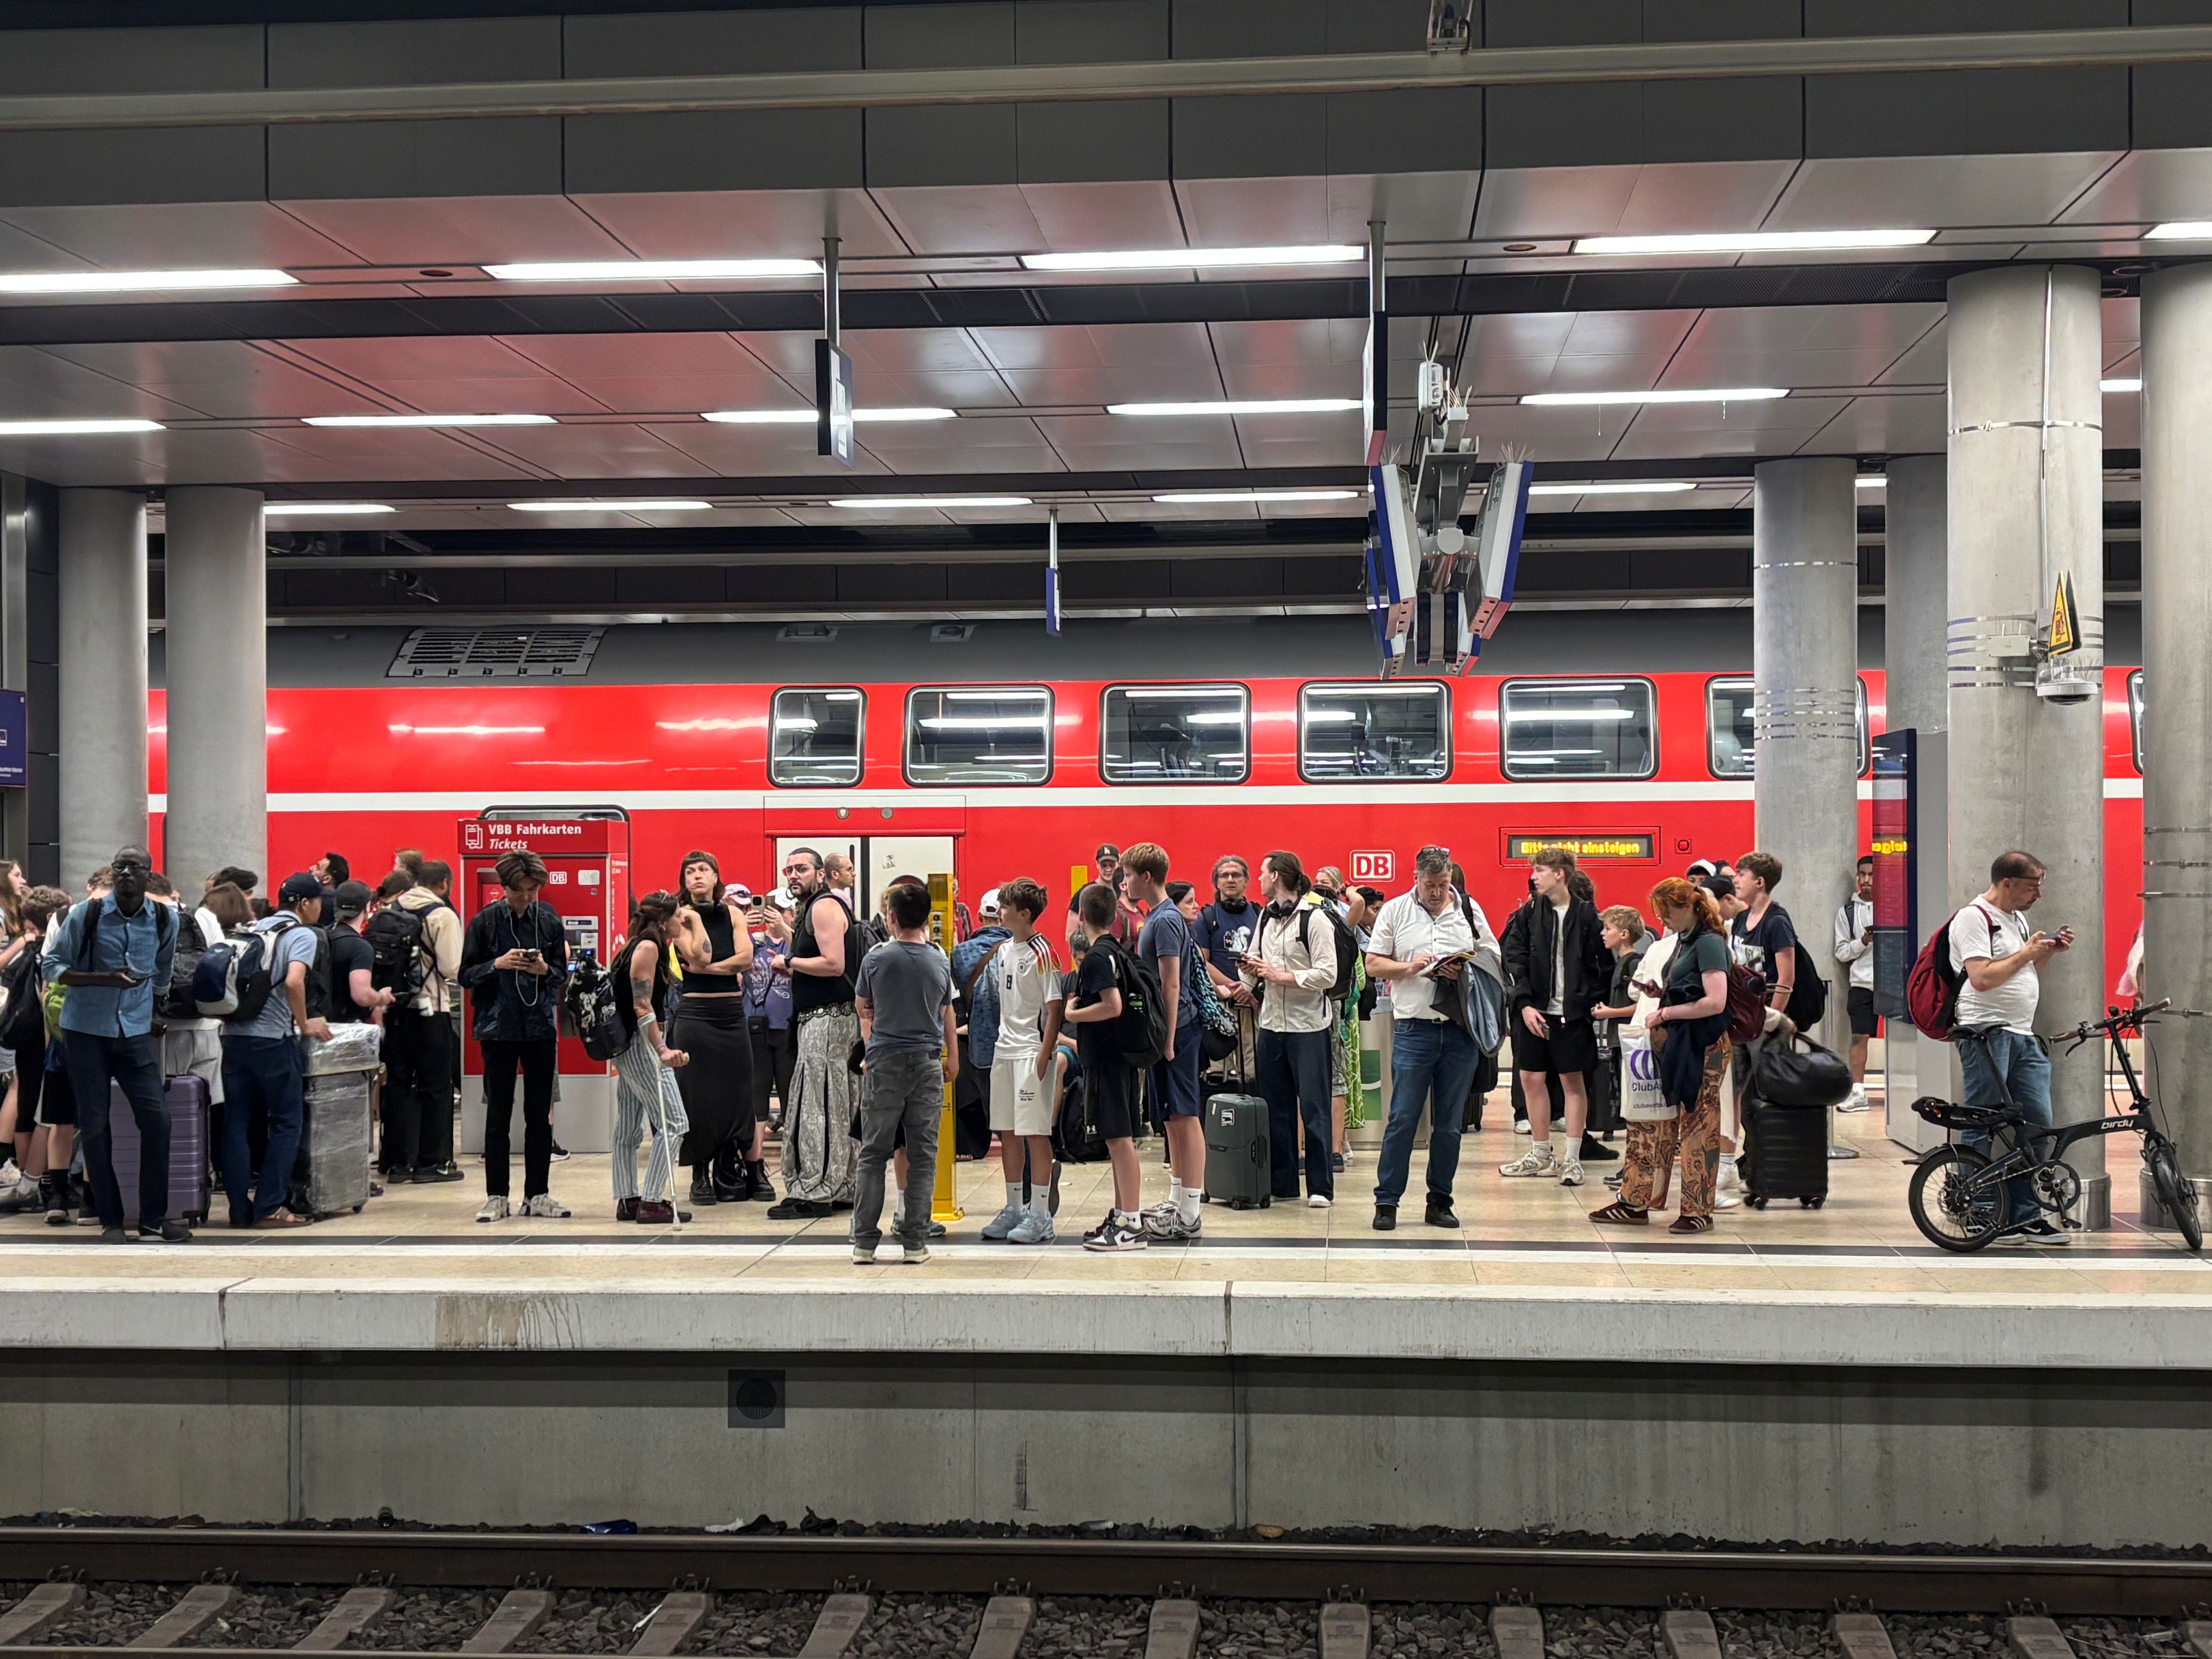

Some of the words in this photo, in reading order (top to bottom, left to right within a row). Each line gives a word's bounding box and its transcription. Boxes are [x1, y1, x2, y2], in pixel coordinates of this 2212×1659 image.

[488, 824, 512, 835] VBB
[516, 823, 582, 835] Fahrkarten
[489, 838, 527, 849] Tickets
[1582, 841, 1640, 855] einsteigen
[1356, 856, 1389, 876] DB
[552, 873, 565, 882] DB
[1006, 975, 1012, 989] 8
[2101, 1119, 2134, 1129] birdy
